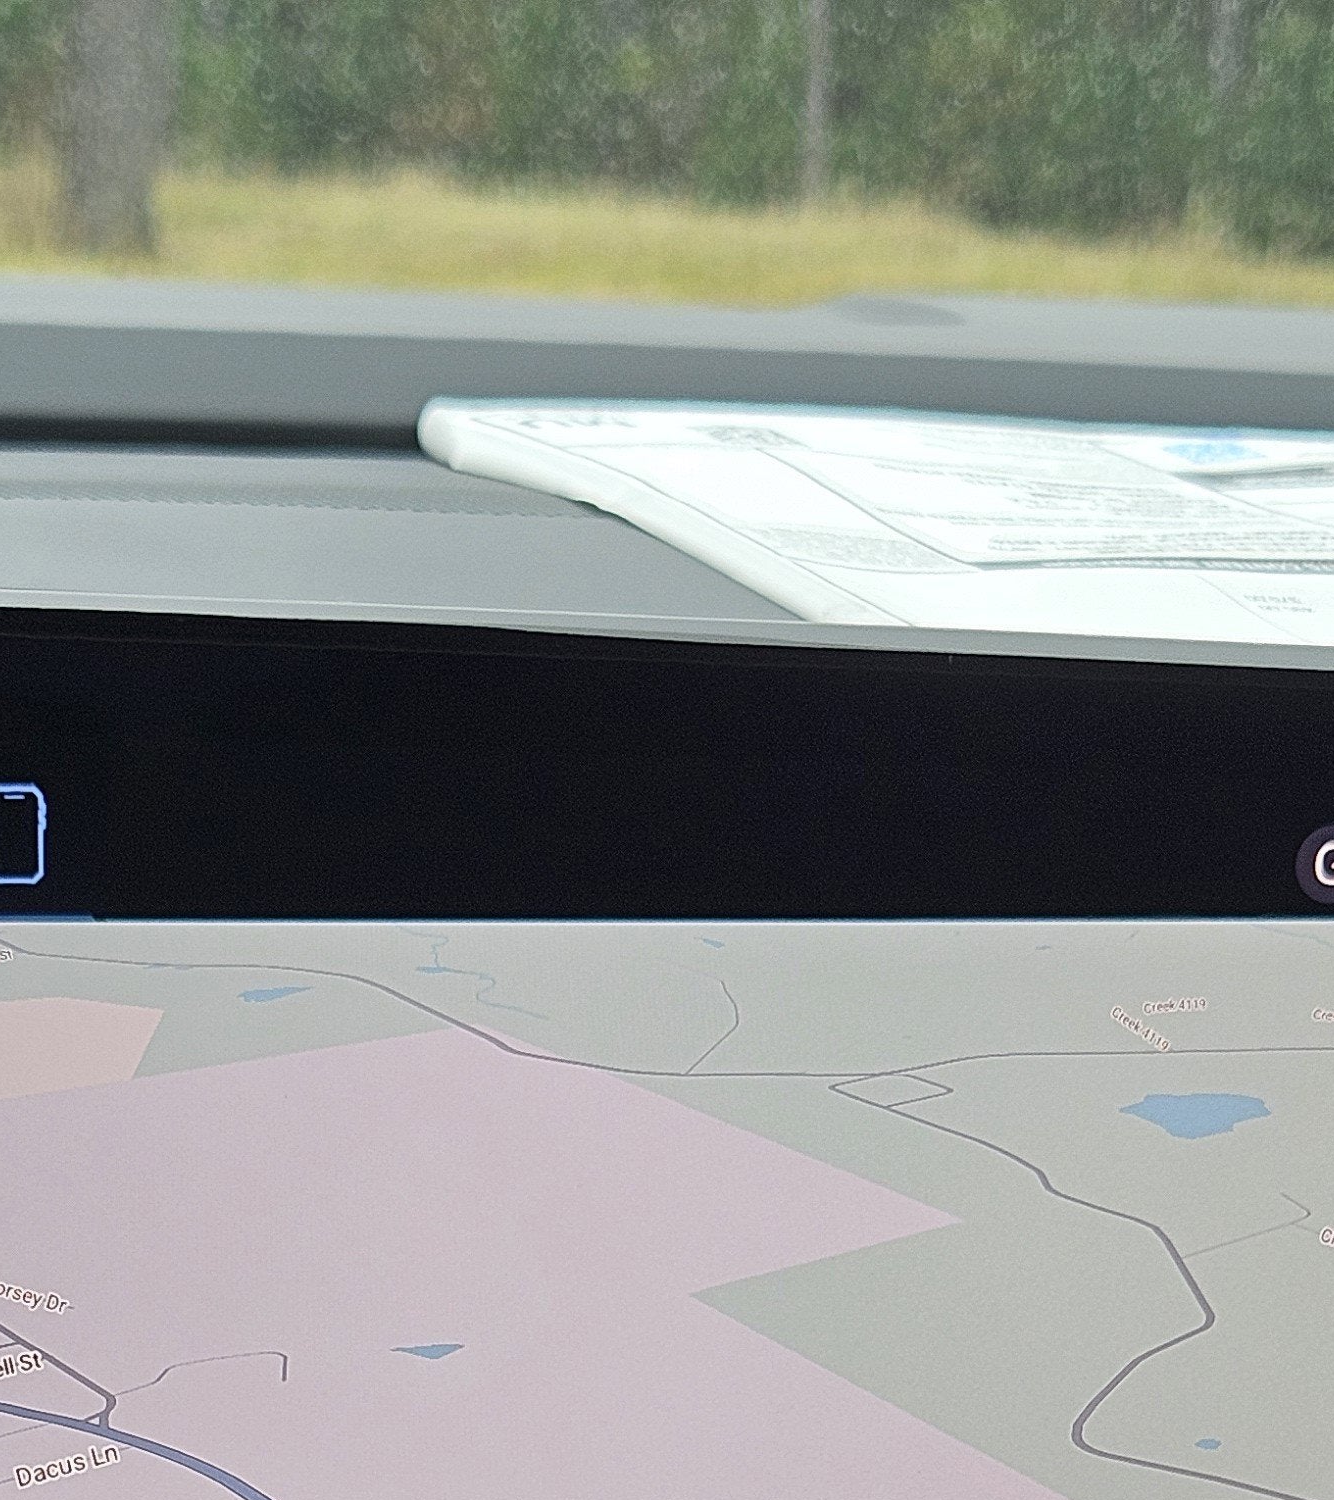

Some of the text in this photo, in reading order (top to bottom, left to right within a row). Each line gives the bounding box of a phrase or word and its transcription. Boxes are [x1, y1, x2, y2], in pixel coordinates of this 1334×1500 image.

[0, 950, 13, 961] St
[1112, 1006, 1142, 1032] Creek
[45, 1293, 69, 1313] Dr
[19, 1352, 42, 1371] St
[15, 1446, 118, 1487] Dacus Ln
